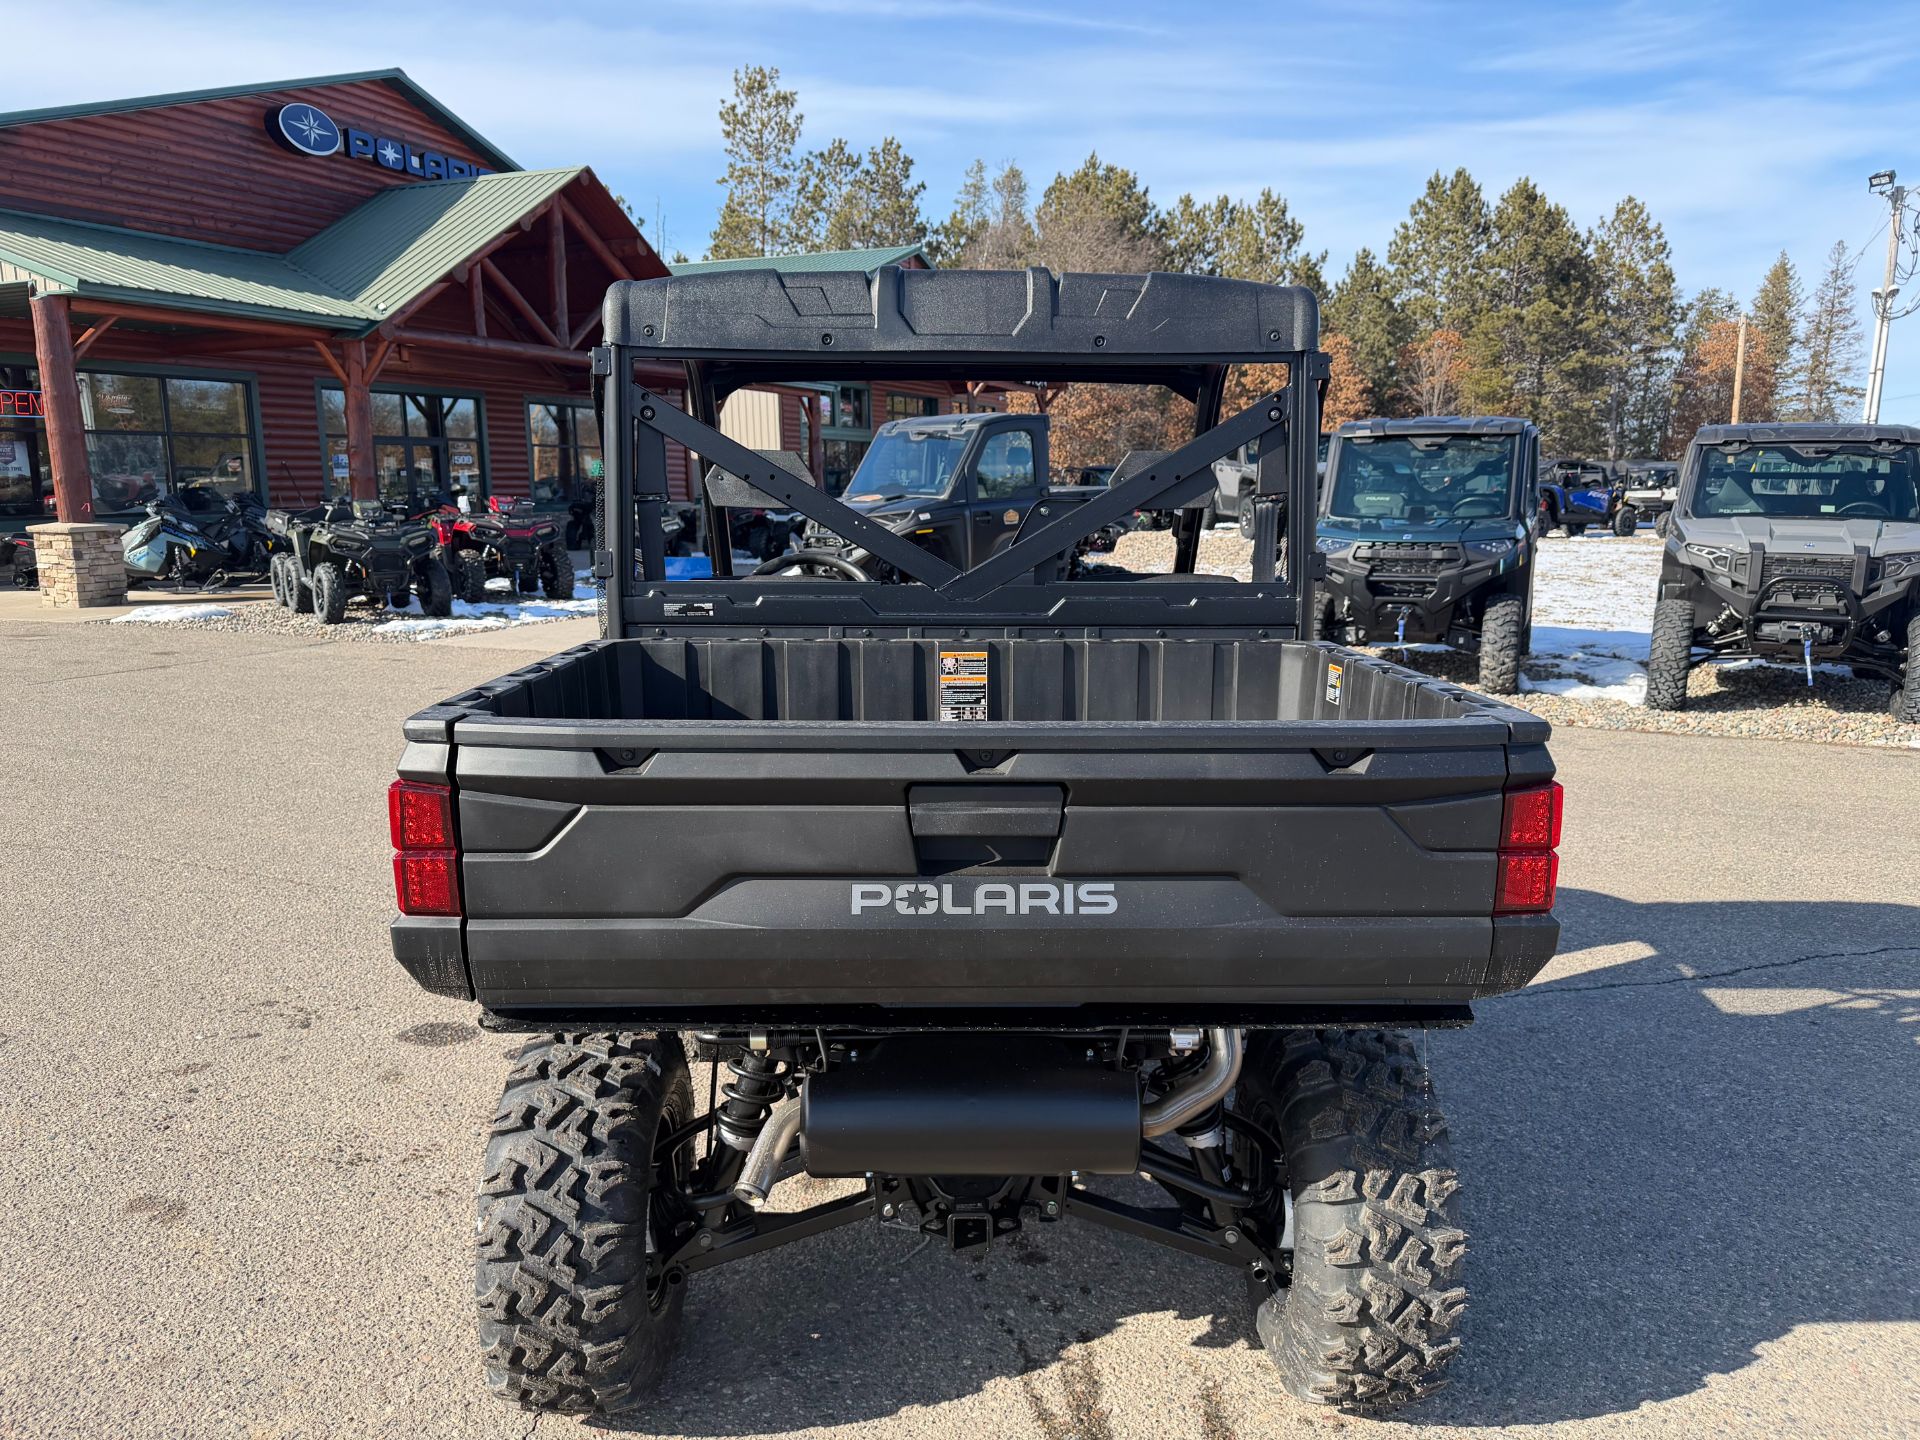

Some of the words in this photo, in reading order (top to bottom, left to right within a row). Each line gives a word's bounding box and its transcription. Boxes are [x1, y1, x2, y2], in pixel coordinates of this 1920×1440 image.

[344, 127, 498, 179] POLAR
[0, 392, 44, 416] PEN
[1774, 567, 1844, 576] POLARIS
[851, 883, 1118, 915] POLARIS
